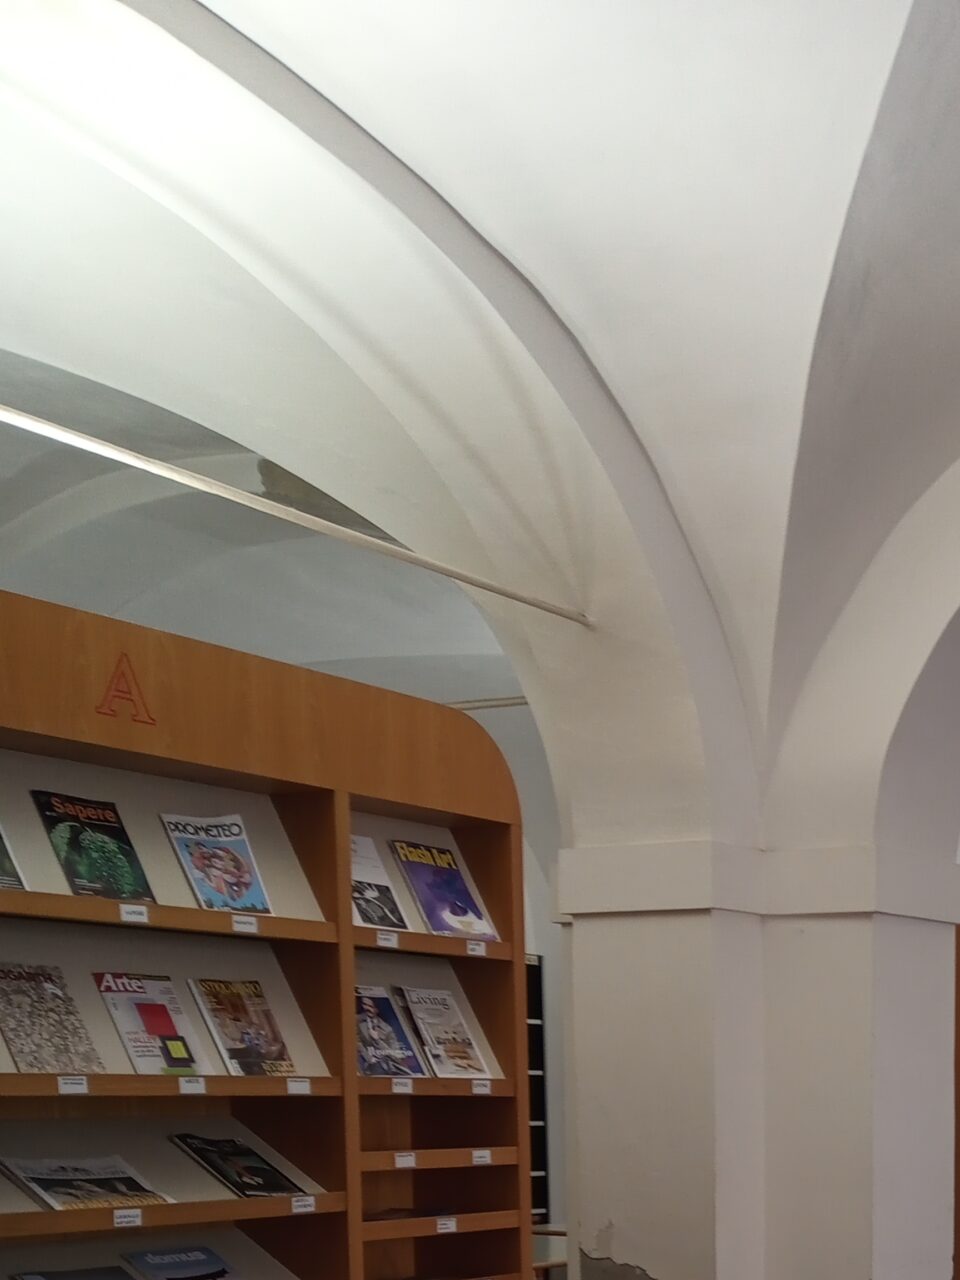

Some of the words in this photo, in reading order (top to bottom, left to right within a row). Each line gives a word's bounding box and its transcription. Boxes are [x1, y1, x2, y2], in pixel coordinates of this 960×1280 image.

[95, 651, 157, 727] A
[50, 796, 117, 822] Sapere
[167, 821, 242, 838] PROMETEO
[393, 841, 434, 866] Flash
[432, 847, 457, 870] Art
[100, 973, 145, 993] Arte
[407, 991, 450, 1010] Living
[144, 1251, 207, 1264] domus
